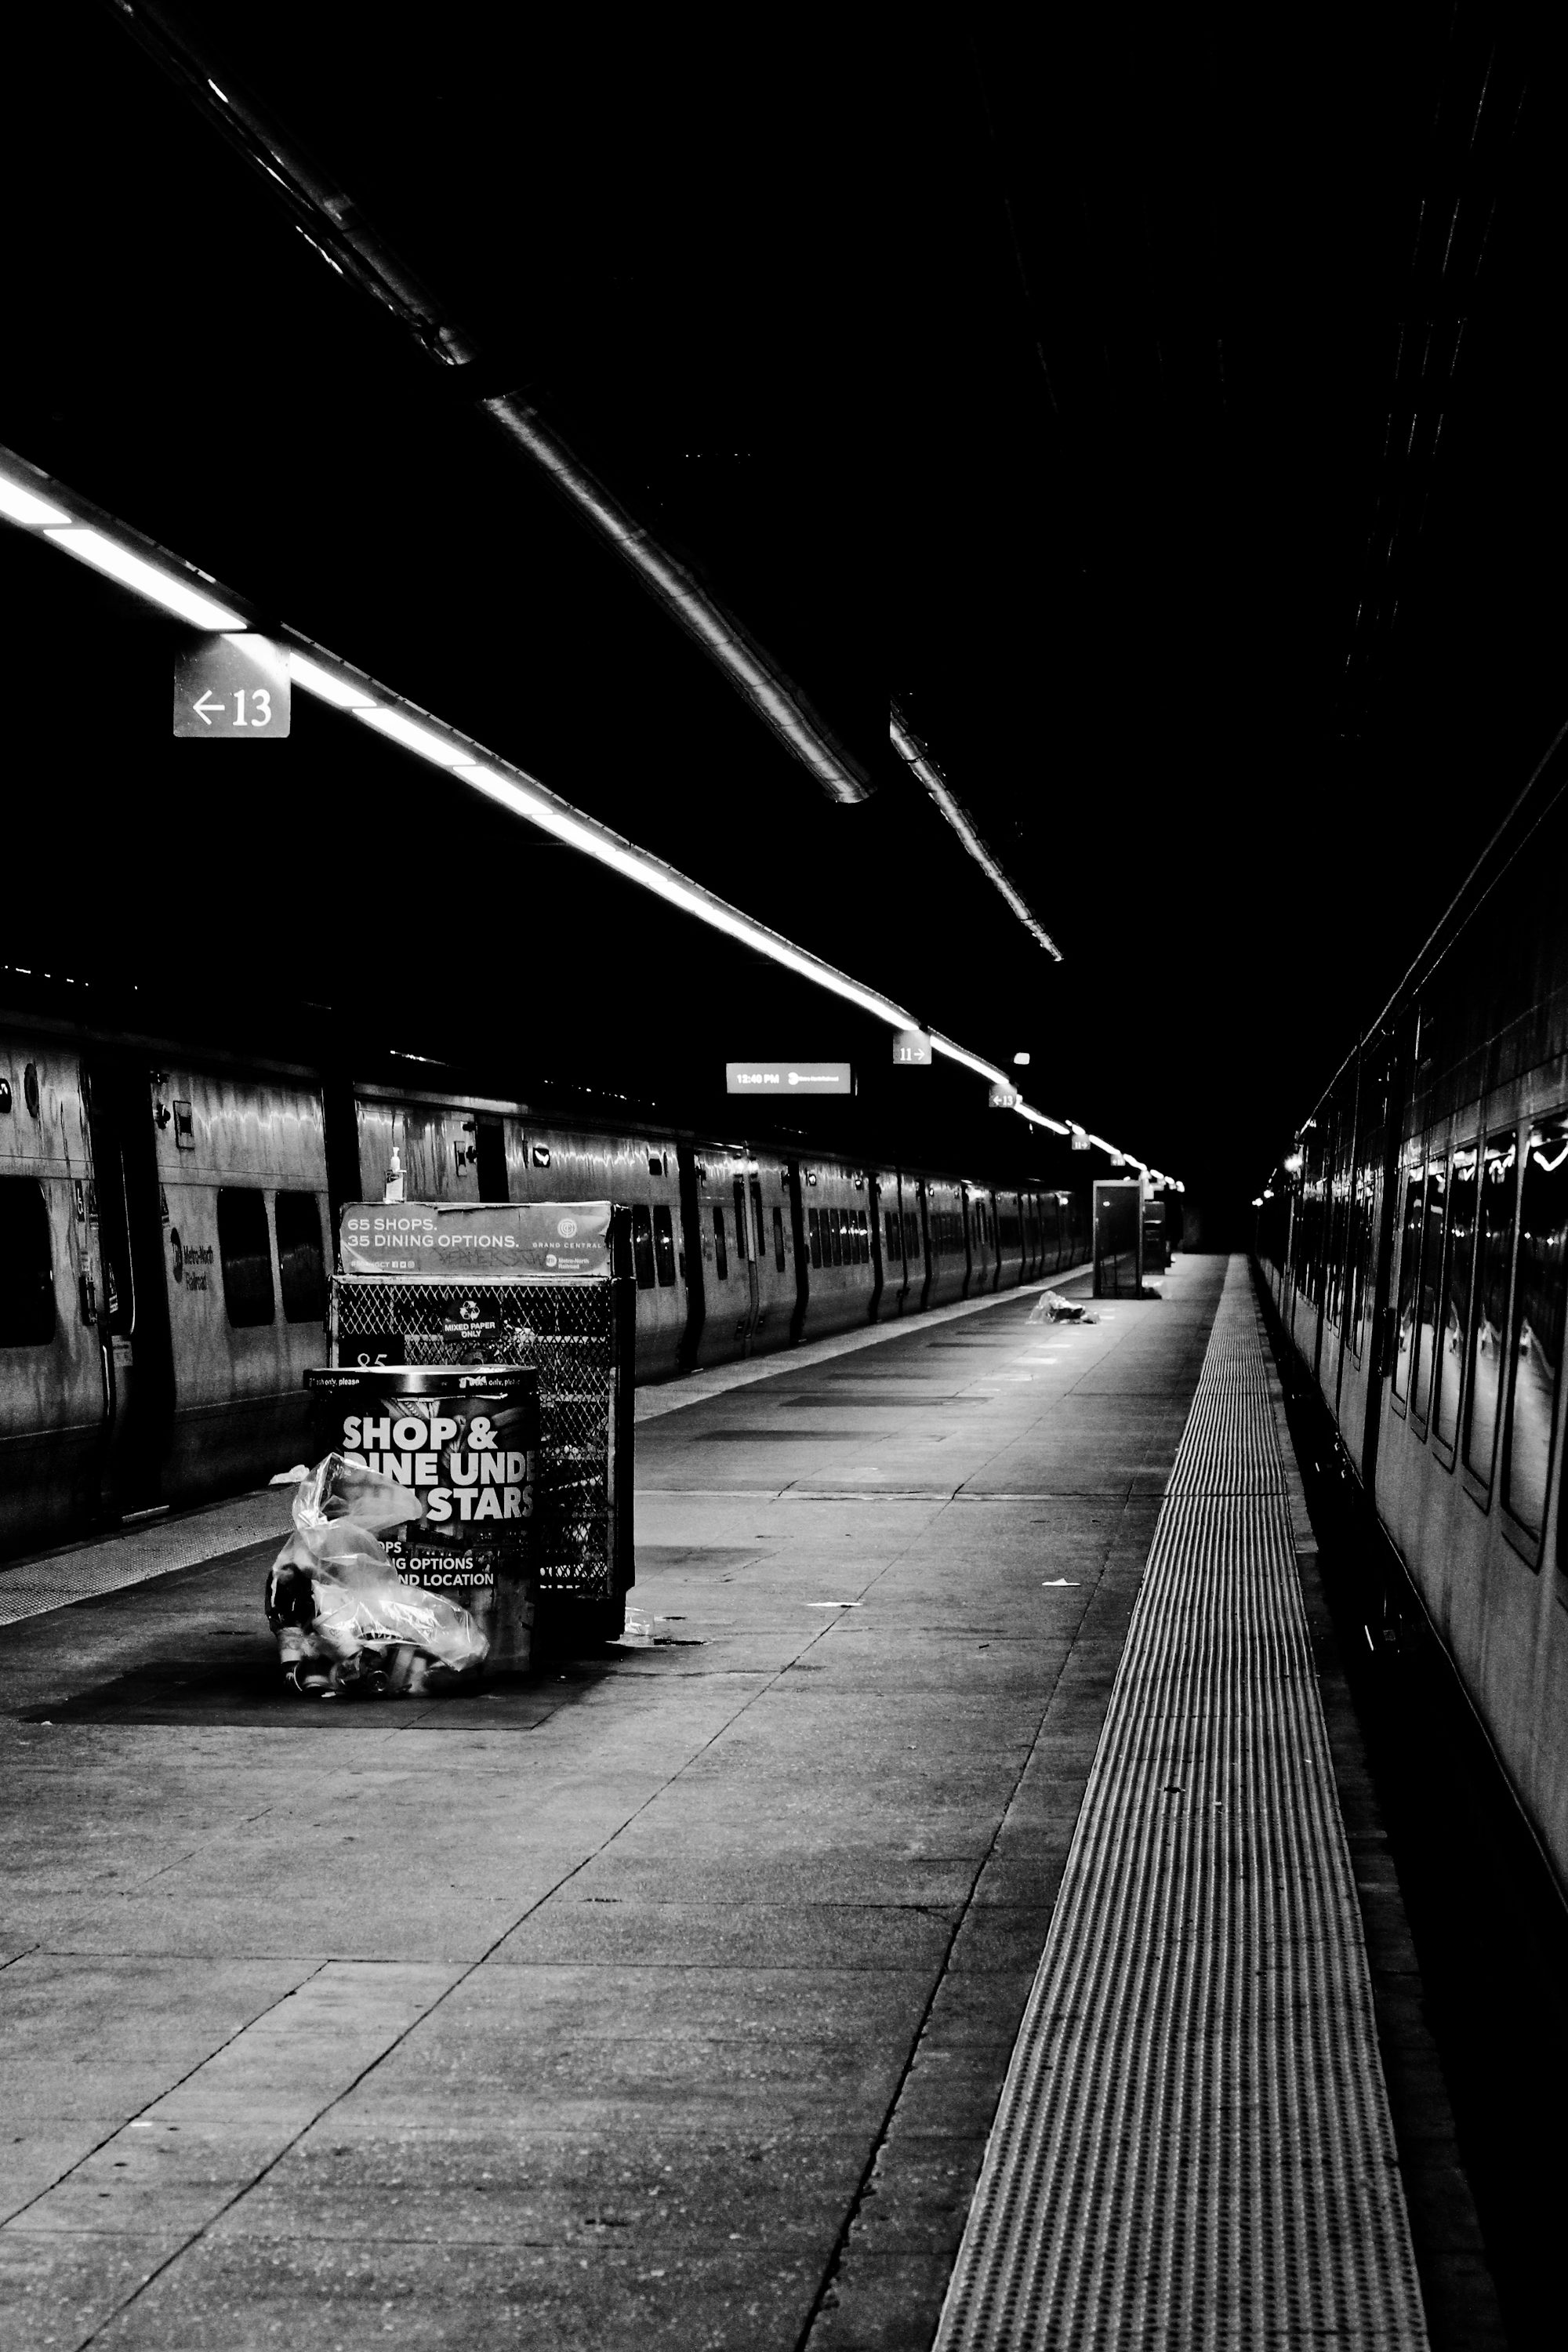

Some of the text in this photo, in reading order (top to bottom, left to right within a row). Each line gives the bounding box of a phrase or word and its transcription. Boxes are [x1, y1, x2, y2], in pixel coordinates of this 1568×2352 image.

[232, 688, 273, 728] 13
[900, 1047, 912, 1062] 11
[763, 1073, 780, 1084] PM
[1003, 1095, 1014, 1106] 13
[347, 1218, 437, 1231] 65 SHOPS.
[347, 1235, 520, 1248] 35 DINING OPTIONS.
[445, 1321, 496, 1332] MIXED PAPER
[461, 1330, 482, 1338] ONLY
[342, 1415, 499, 1450] SHOP &
[449, 1450, 539, 1486] UNDE
[426, 1484, 534, 1522] STARS
[409, 1557, 474, 1570] OPTIONS
[423, 1573, 495, 1587] LOCATION
